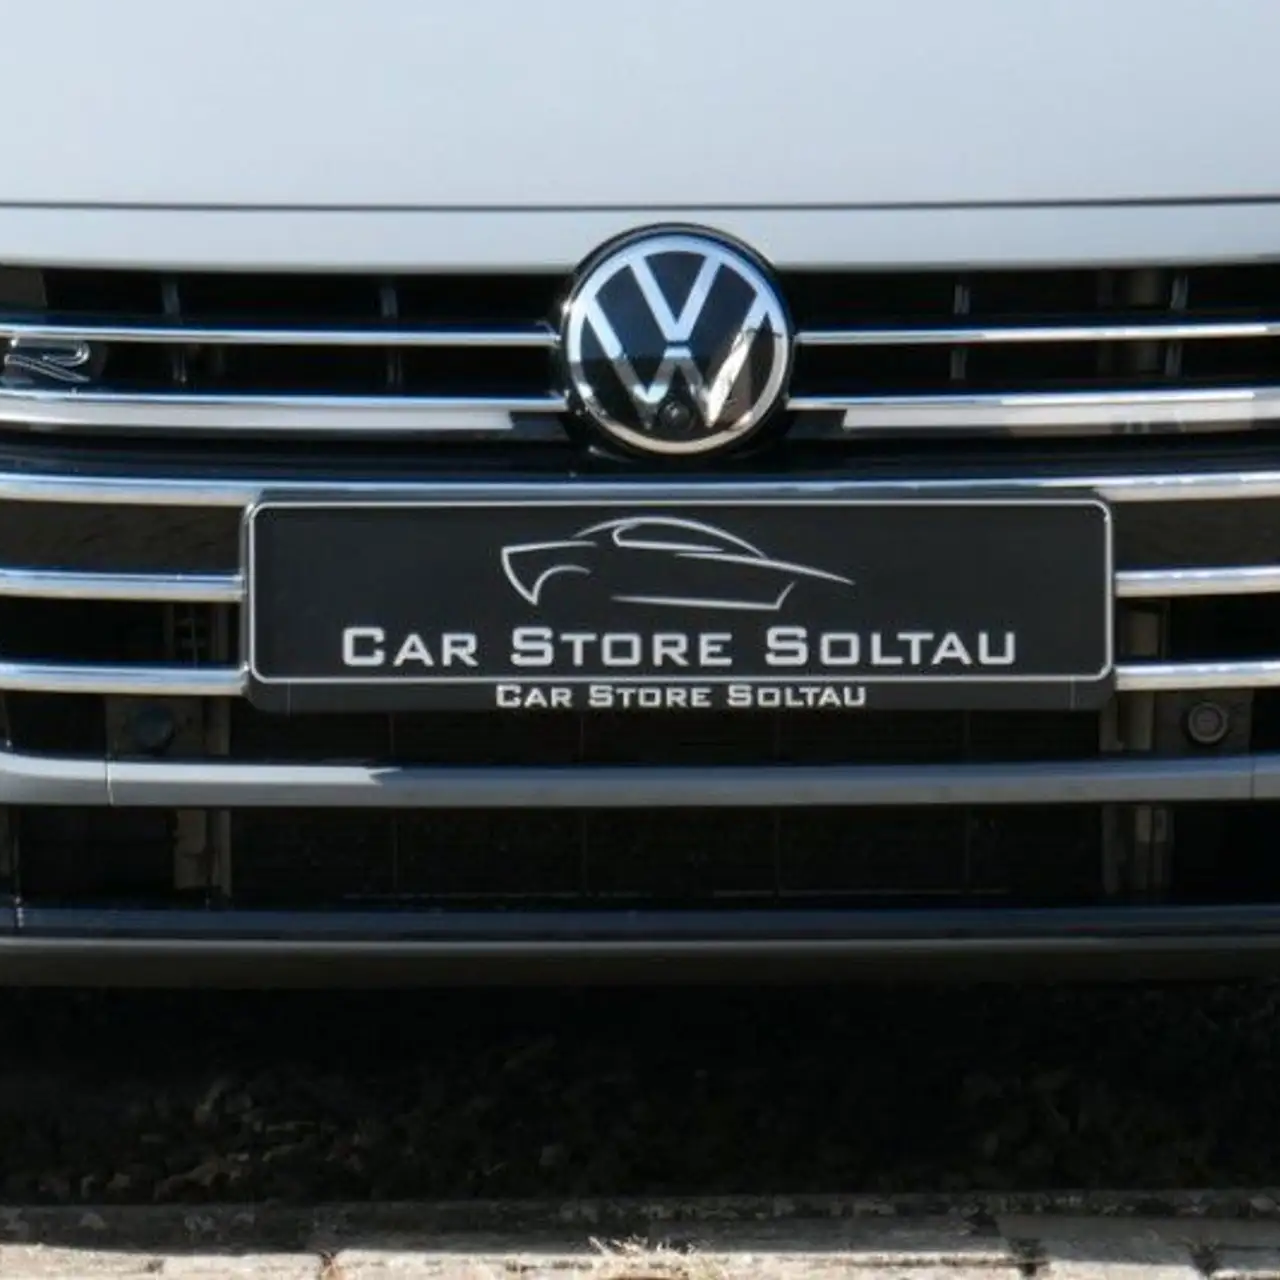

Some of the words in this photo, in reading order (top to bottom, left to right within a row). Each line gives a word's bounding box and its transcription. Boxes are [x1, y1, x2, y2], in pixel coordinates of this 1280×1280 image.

[343, 626, 479, 668] CAR
[510, 626, 733, 668] STORE
[764, 626, 1016, 667] SOLTAU
[496, 684, 572, 709] CAR
[588, 684, 711, 709] STORE
[726, 684, 867, 708] SOLTAU
